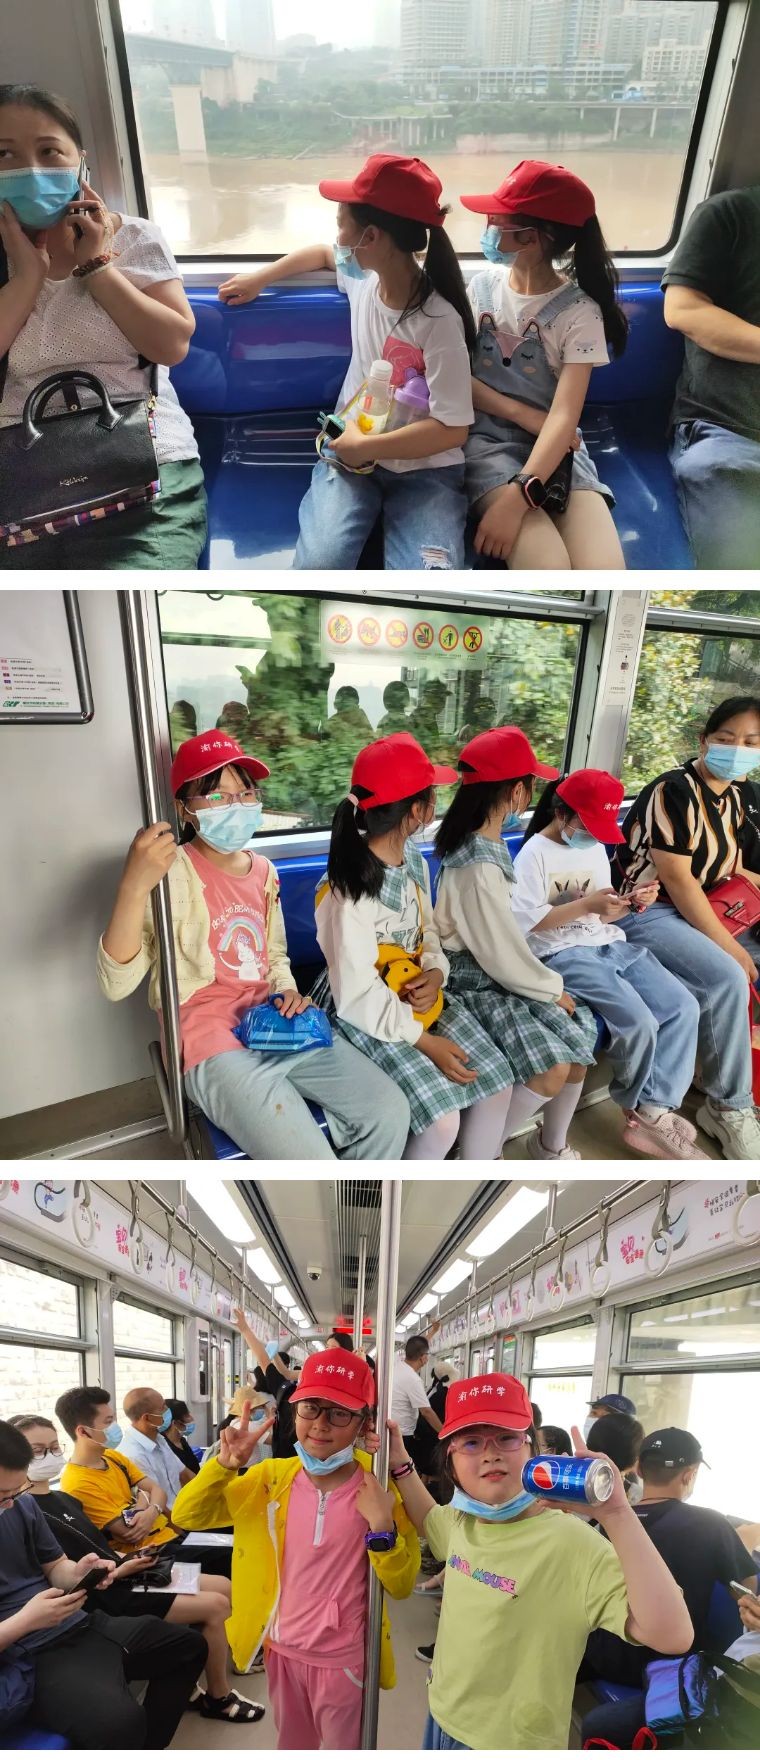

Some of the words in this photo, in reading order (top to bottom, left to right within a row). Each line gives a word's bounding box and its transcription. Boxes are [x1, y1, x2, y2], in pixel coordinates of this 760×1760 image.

[200, 740, 240, 753] 渝你研
[472, 1568, 516, 1595] MOUSE
